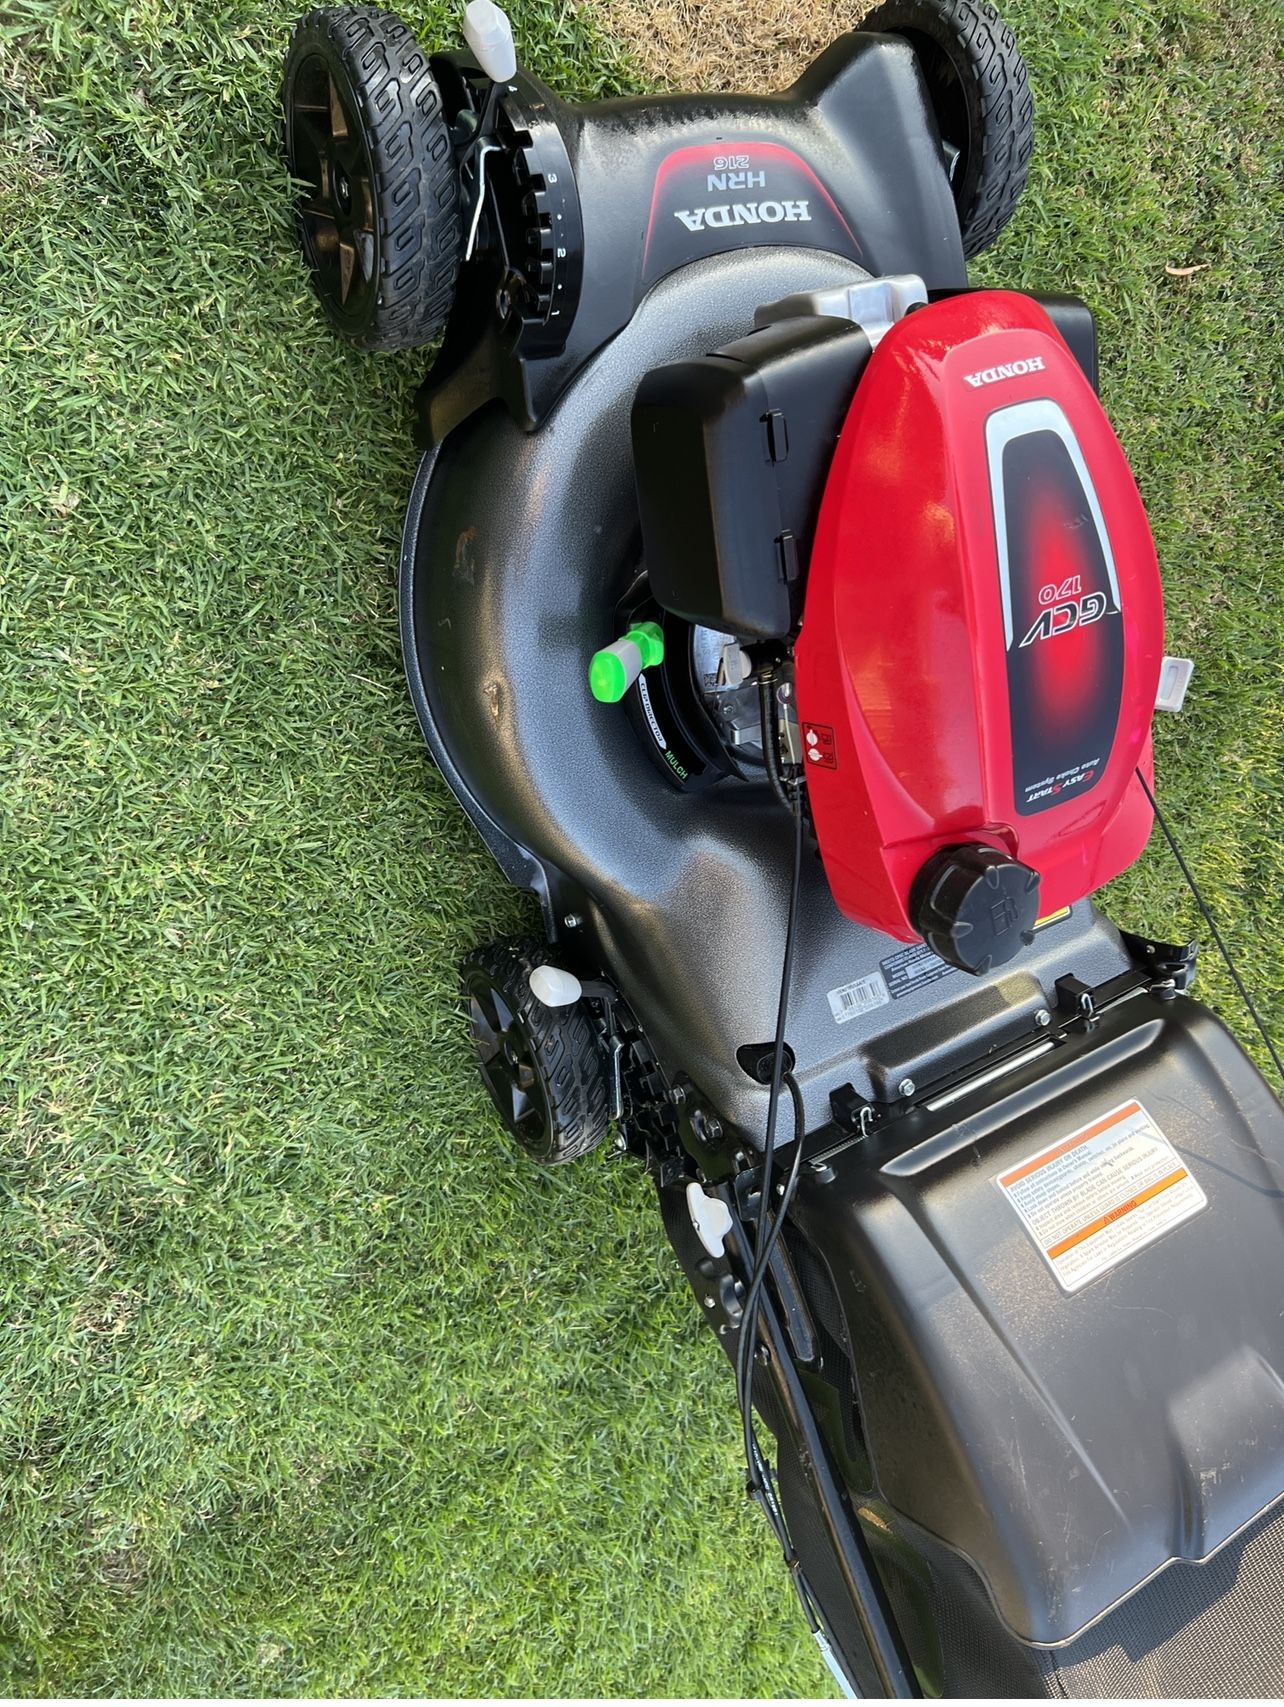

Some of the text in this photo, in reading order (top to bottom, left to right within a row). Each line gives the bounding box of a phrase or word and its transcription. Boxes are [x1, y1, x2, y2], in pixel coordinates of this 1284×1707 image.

[713, 155, 749, 171] 216
[548, 173, 558, 184] 3
[707, 170, 766, 192] HRN
[674, 200, 812, 232] HONDA
[557, 248, 566, 258] 2
[963, 356, 1046, 388] HONDA
[1038, 575, 1082, 605] 170
[1018, 591, 1107, 648] GCV
[665, 750, 688, 779] MULCH
[1025, 758, 1100, 792] Auto Choke System
[1109, 1200, 1138, 1221] WARNING
